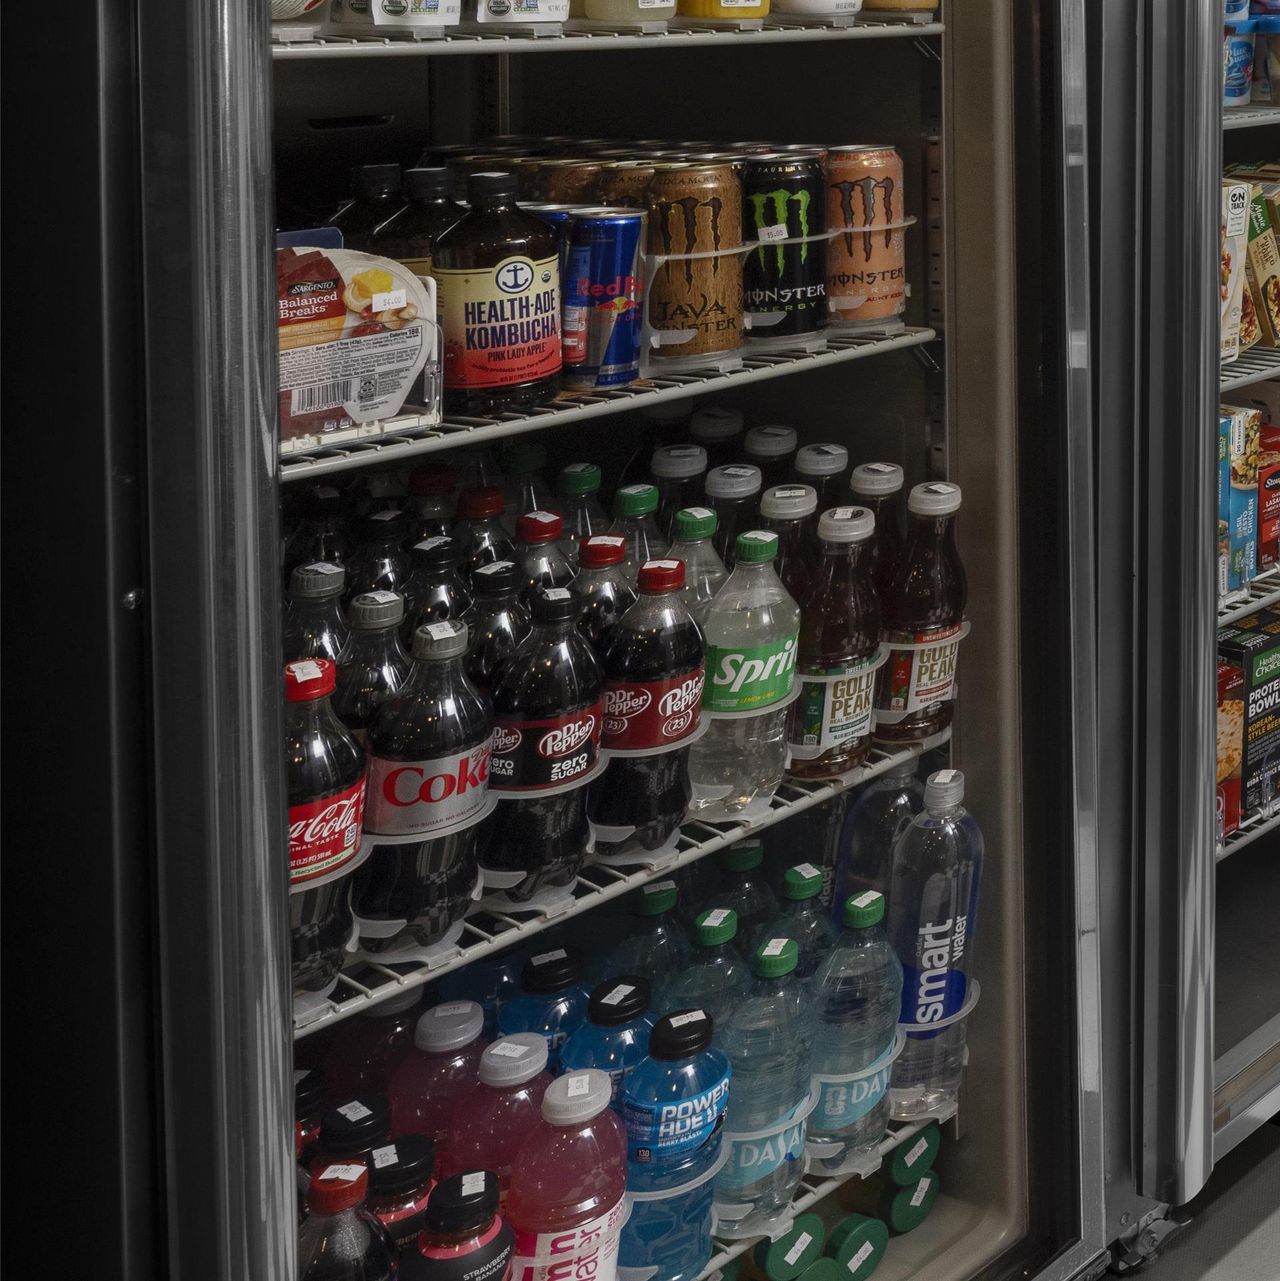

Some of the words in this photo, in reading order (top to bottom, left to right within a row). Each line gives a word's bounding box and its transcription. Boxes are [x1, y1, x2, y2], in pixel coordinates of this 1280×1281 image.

[279, 292, 338, 309] Balanced
[280, 305, 326, 318] Breaks
[466, 315, 556, 350] KOMBUCHA
[488, 349, 506, 363] PINK
[552, 753, 587, 771] zero
[550, 763, 587, 781] SUGAR
[952, 916, 967, 962] water
[916, 919, 953, 1024] smart
